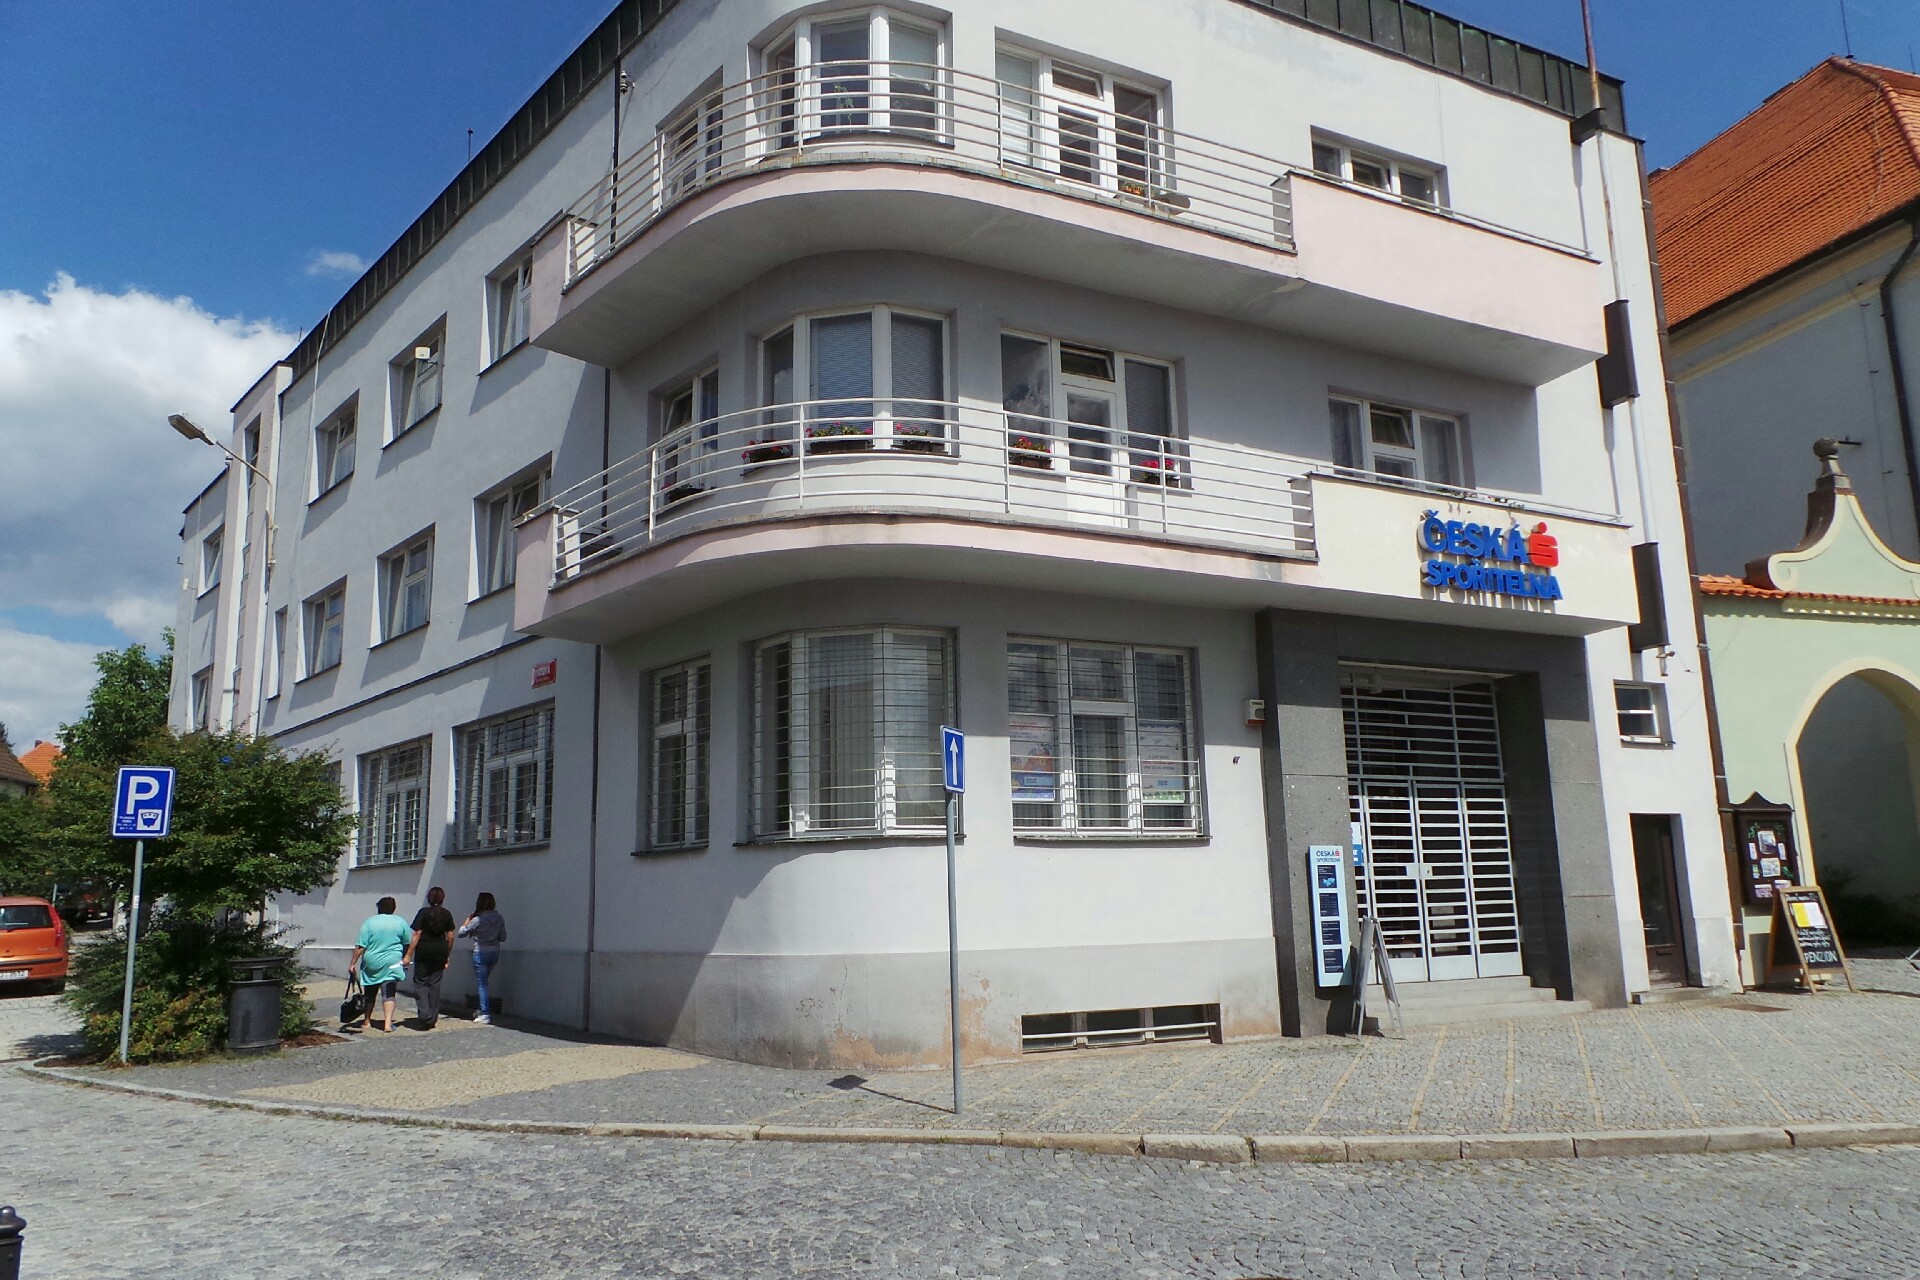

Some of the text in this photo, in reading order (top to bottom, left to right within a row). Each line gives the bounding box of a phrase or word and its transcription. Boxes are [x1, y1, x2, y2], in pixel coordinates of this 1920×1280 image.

[1420, 509, 1529, 565] ČESKÁ
[1424, 559, 1563, 600] SPOŘITELNA
[126, 775, 160, 815] P
[1804, 950, 1838, 963] PENZION
